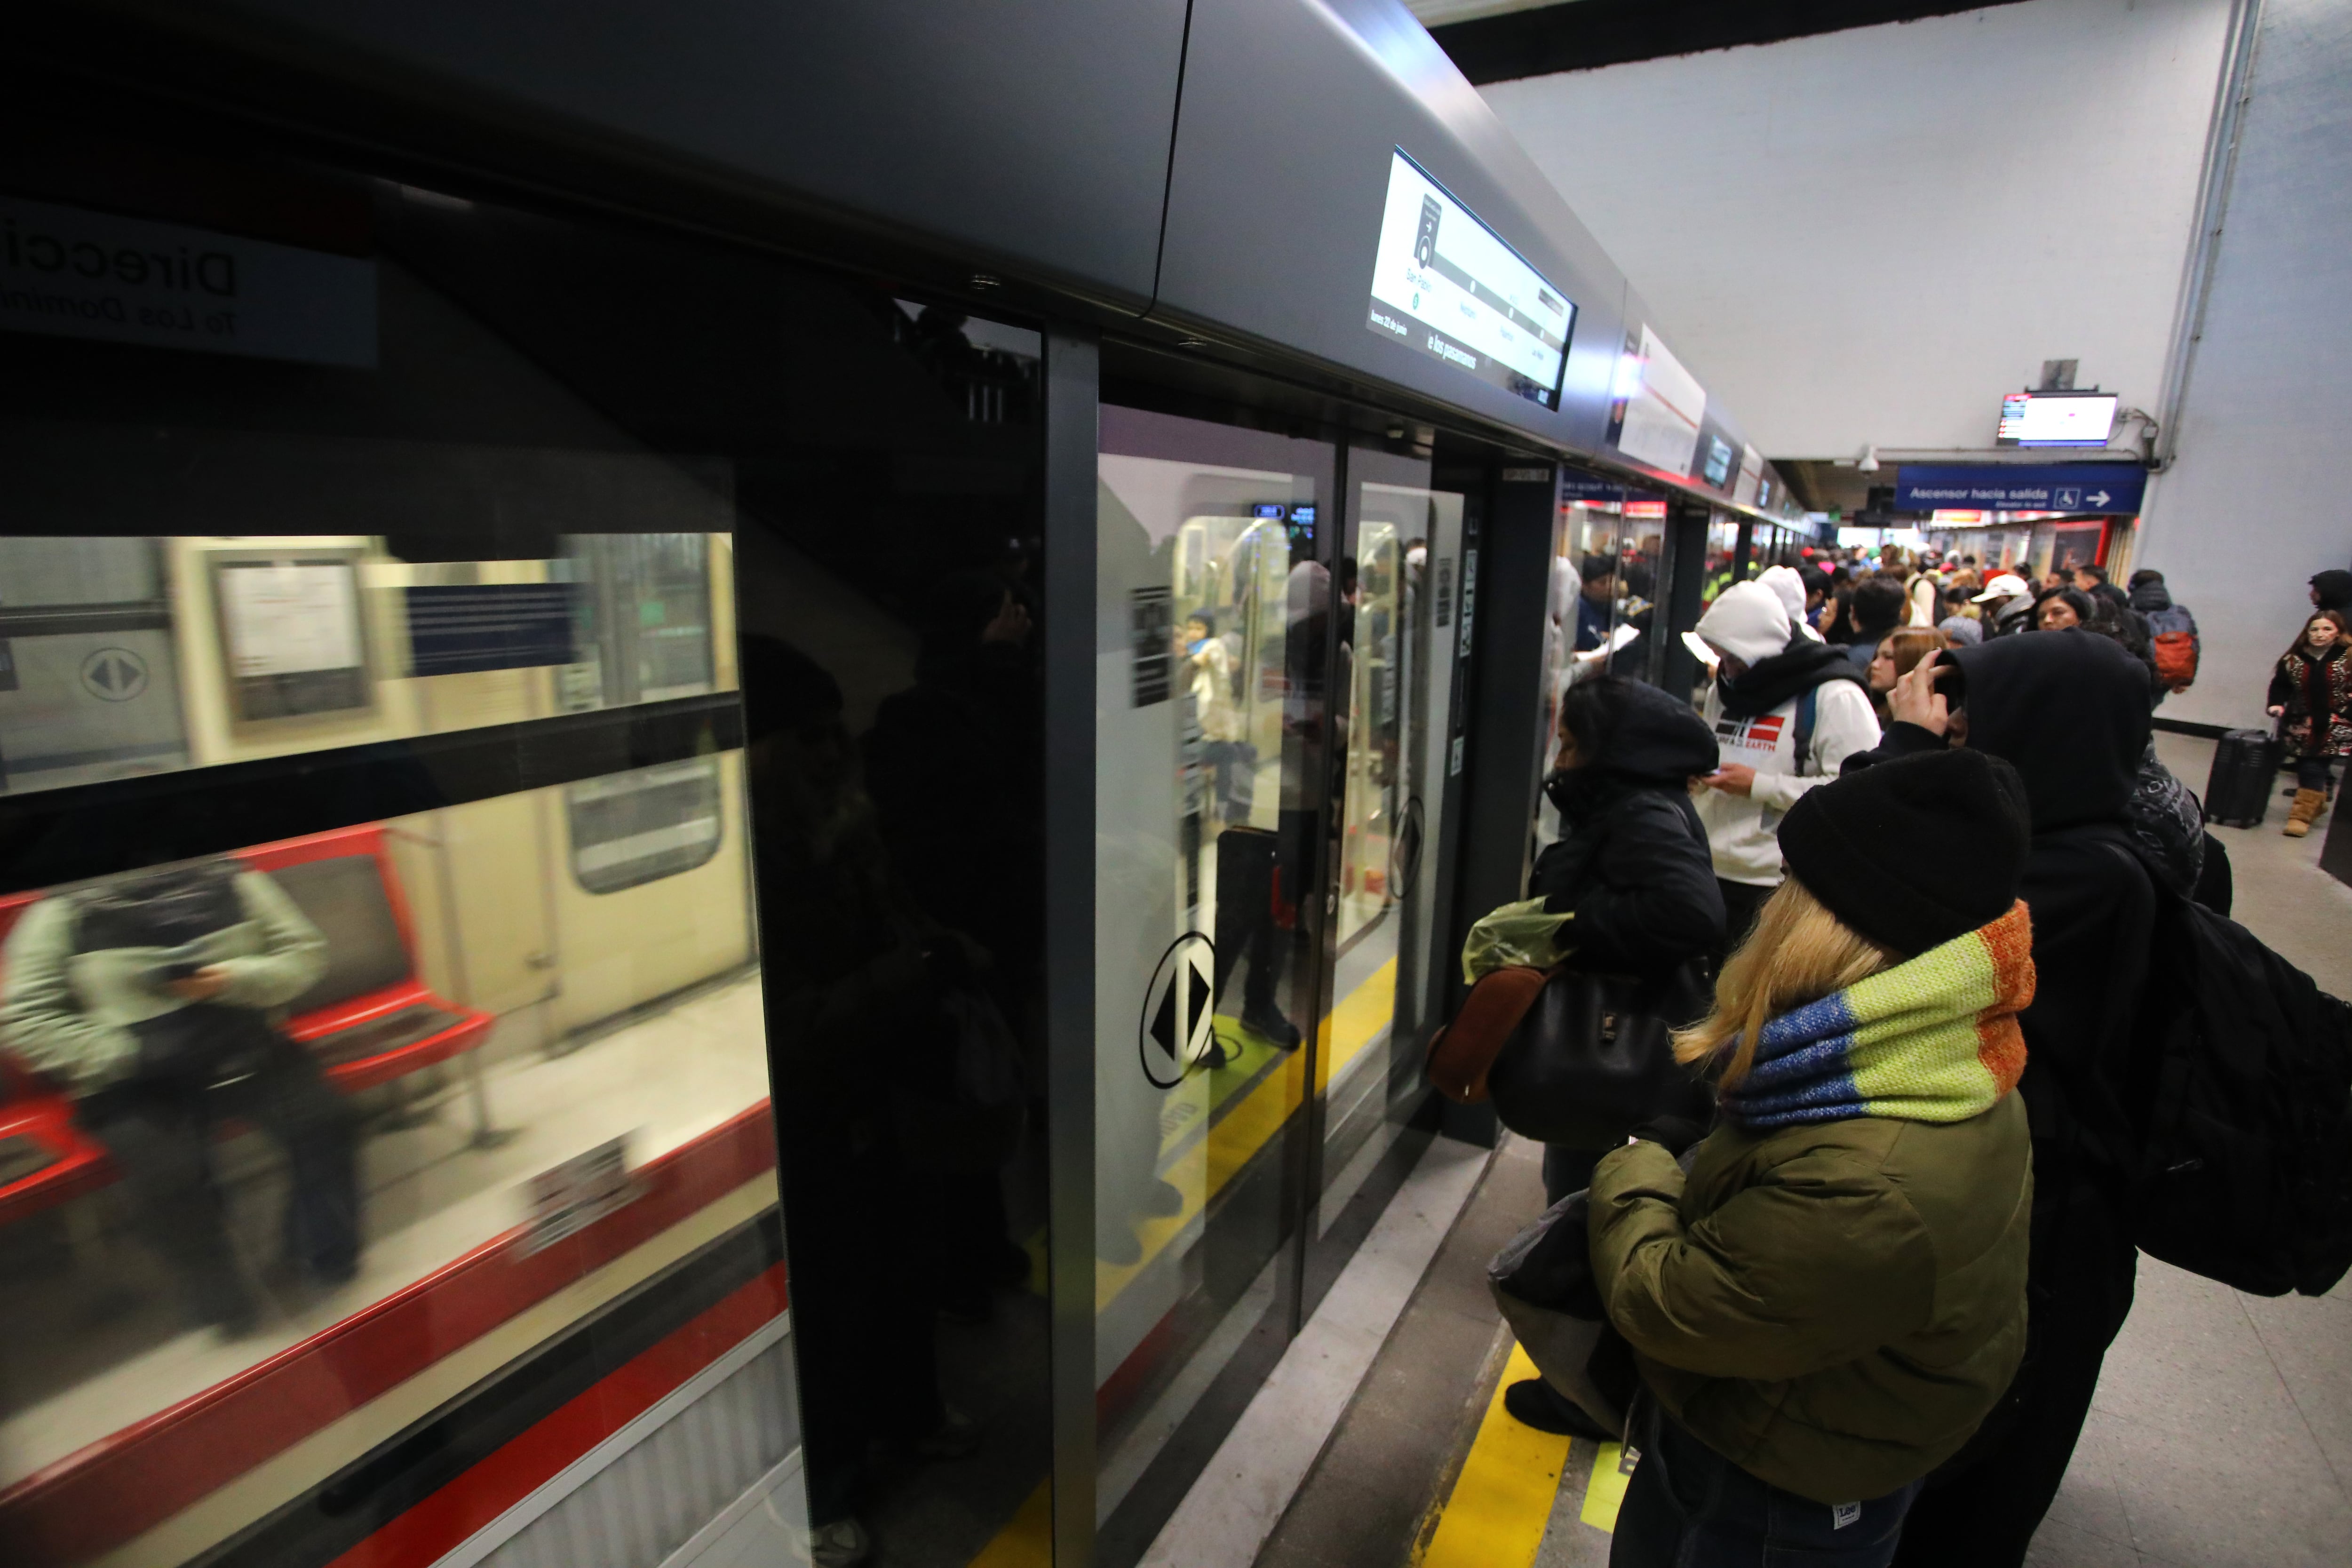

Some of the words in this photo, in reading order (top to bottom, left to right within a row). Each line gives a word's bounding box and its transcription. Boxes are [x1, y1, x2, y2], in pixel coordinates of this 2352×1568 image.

[1406, 267, 1416, 282] San
[1370, 309, 1384, 325] lunes
[1383, 316, 1391, 328] 22
[1390, 318, 1396, 331] de
[1395, 321, 1407, 336] junio
[1433, 334, 1444, 355] los
[1442, 344, 1477, 370] pasamanos
[1910, 487, 1968, 499] Ascensor
[1971, 488, 2005, 499] hacia
[2009, 488, 2048, 500] salida
[1746, 740, 1776, 752] EARTH
[1839, 1505, 1856, 1517] Lee
